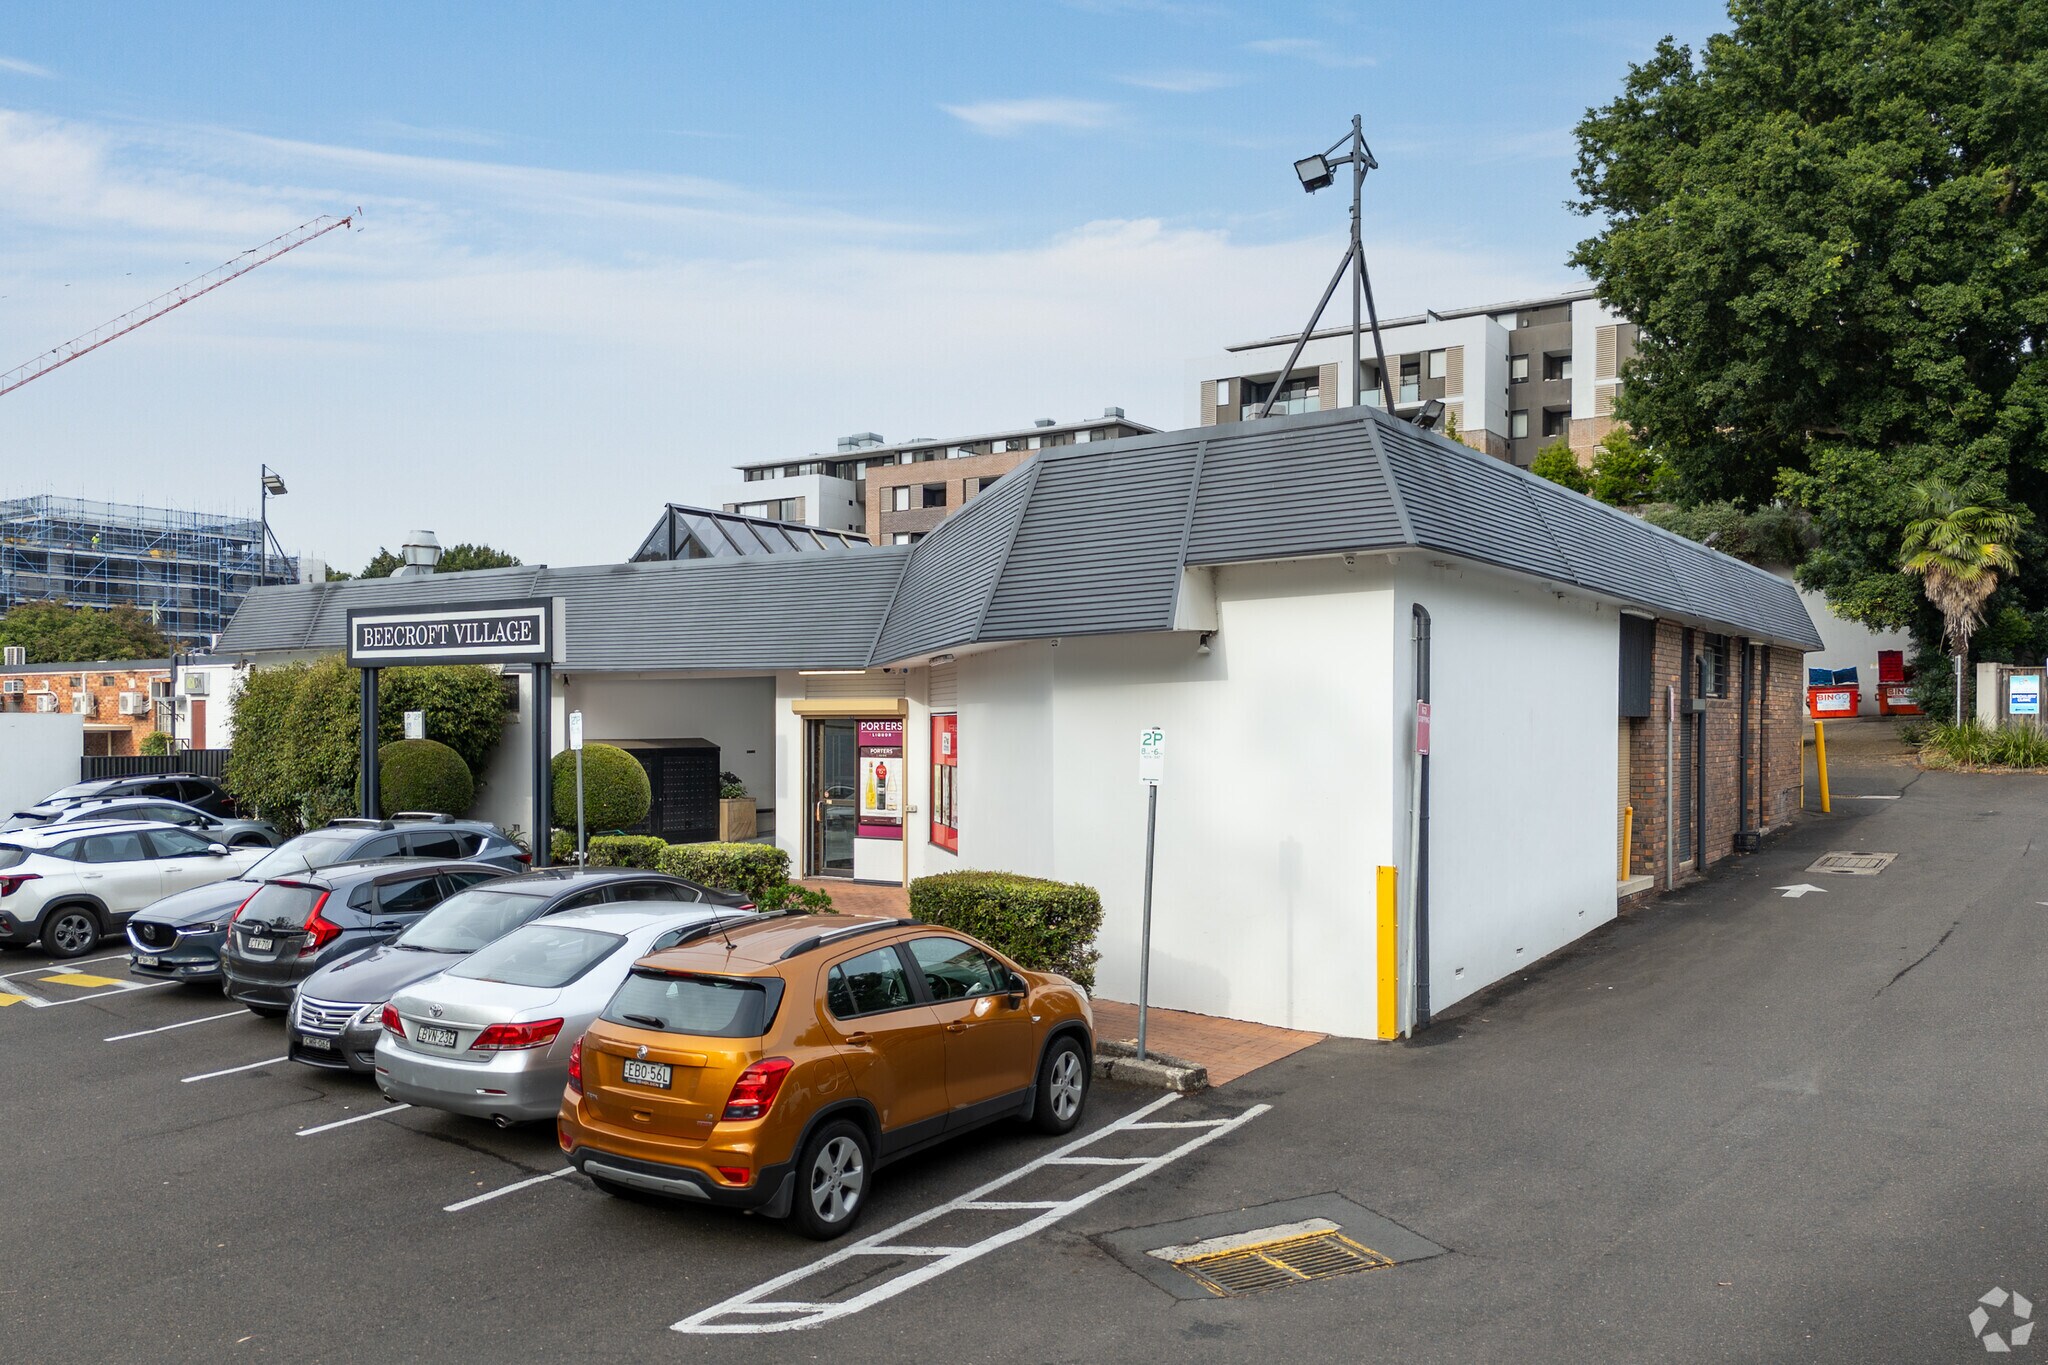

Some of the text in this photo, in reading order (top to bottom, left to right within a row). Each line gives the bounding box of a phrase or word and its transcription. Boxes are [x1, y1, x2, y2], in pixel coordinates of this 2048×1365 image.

[363, 620, 532, 647] BEECROFT VILLAGE
[1817, 693, 1849, 701] BINGO
[861, 721, 903, 731] PORTERS
[1142, 732, 1163, 746] 2P
